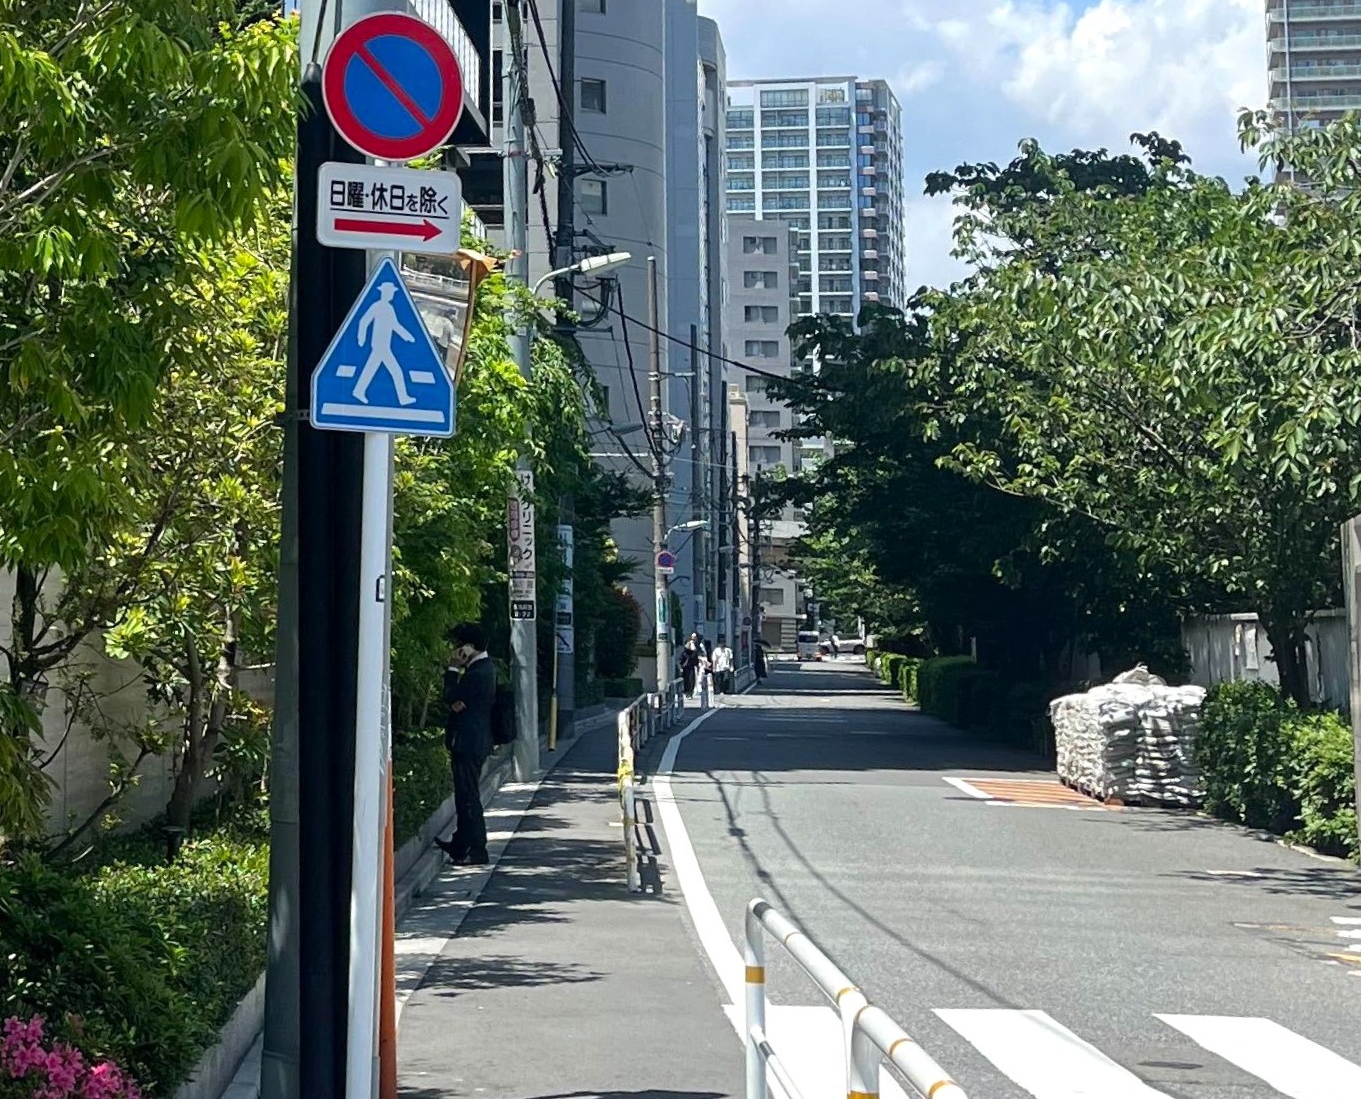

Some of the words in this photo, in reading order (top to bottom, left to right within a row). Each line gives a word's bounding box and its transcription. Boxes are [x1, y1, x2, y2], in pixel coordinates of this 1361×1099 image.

[330, 180, 449, 216] 日曜・休日を除く
[520, 474, 532, 560] けクリニック
